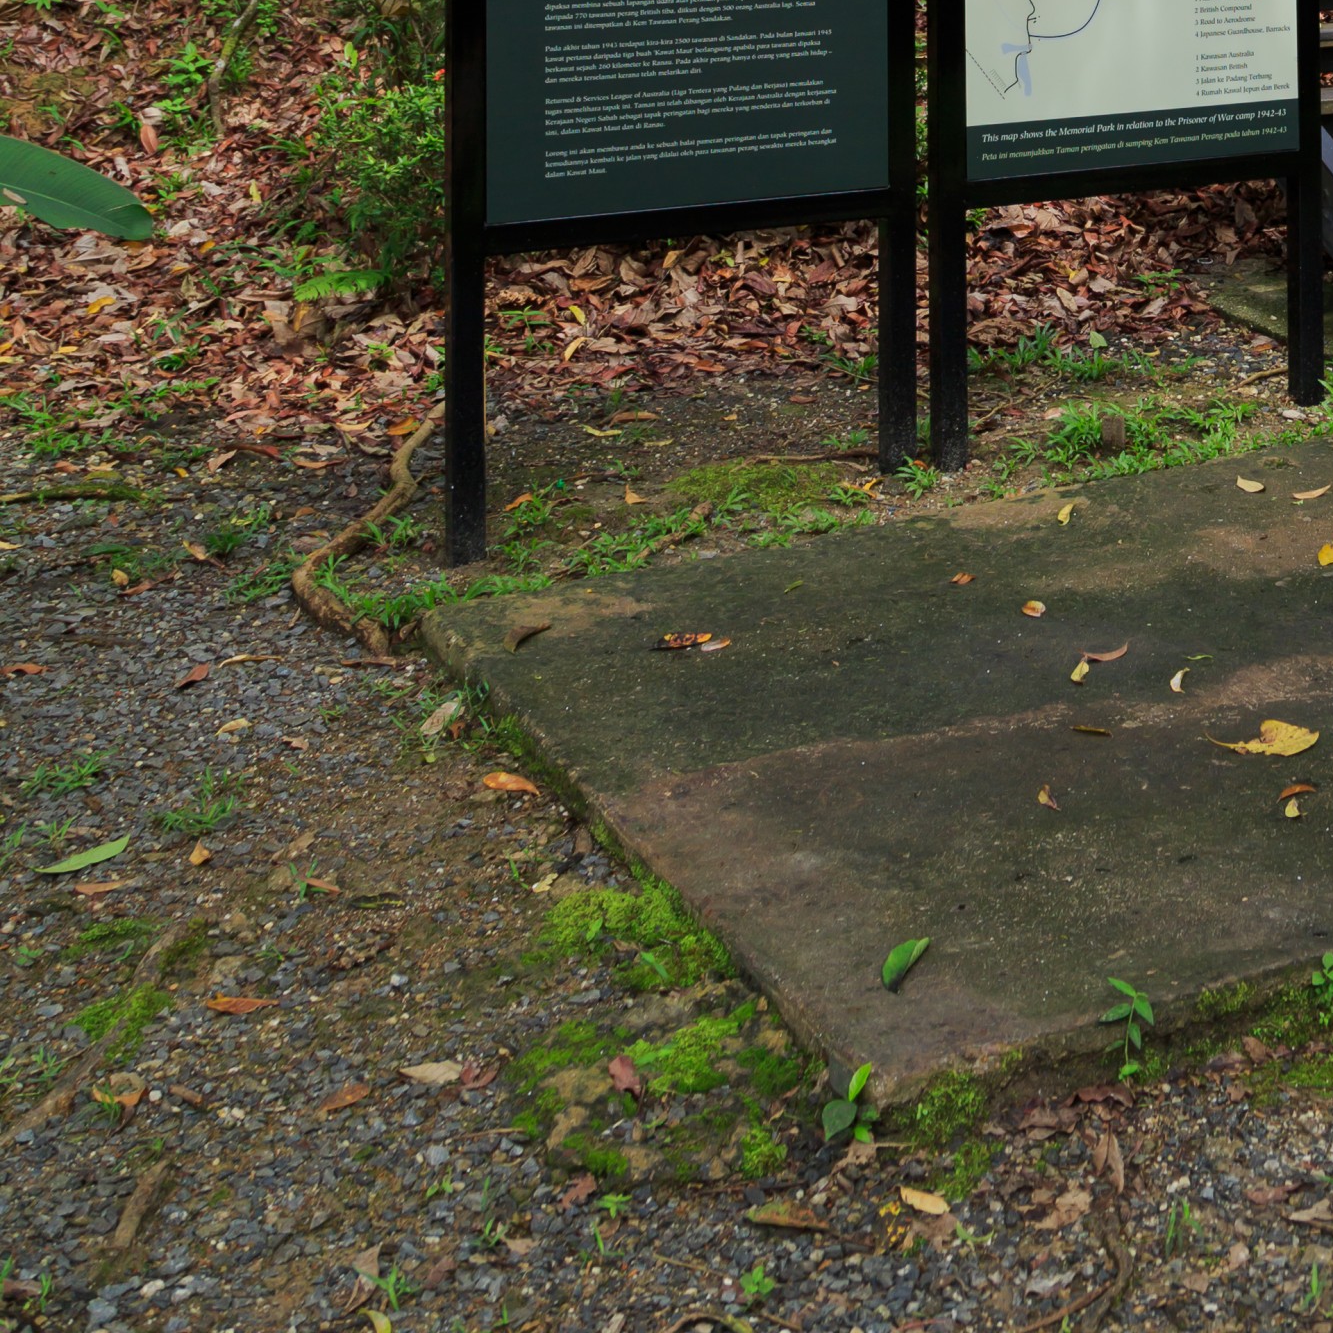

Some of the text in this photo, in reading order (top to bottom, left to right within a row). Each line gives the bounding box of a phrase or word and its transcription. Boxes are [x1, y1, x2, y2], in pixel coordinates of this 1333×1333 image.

[982, 134, 999, 142] This
[1020, 131, 1043, 139] shows
[1059, 125, 1095, 135] Memorial
[1097, 123, 1115, 132] Park
[1126, 121, 1153, 130] relation
[1178, 117, 1207, 125] Prisoner
[1235, 113, 1255, 121] camp
[1258, 108, 1286, 118] 1942-43
[982, 153, 997, 161] Peta
[1056, 146, 1079, 154] Taman
[1081, 143, 1116, 153] peringatan
[1125, 140, 1153, 148] samping
[1170, 135, 1199, 143] Tawanan
[1201, 133, 1223, 141] Perang
[1242, 129, 1260, 137] tahun
[1262, 126, 1287, 135] 1942-43
